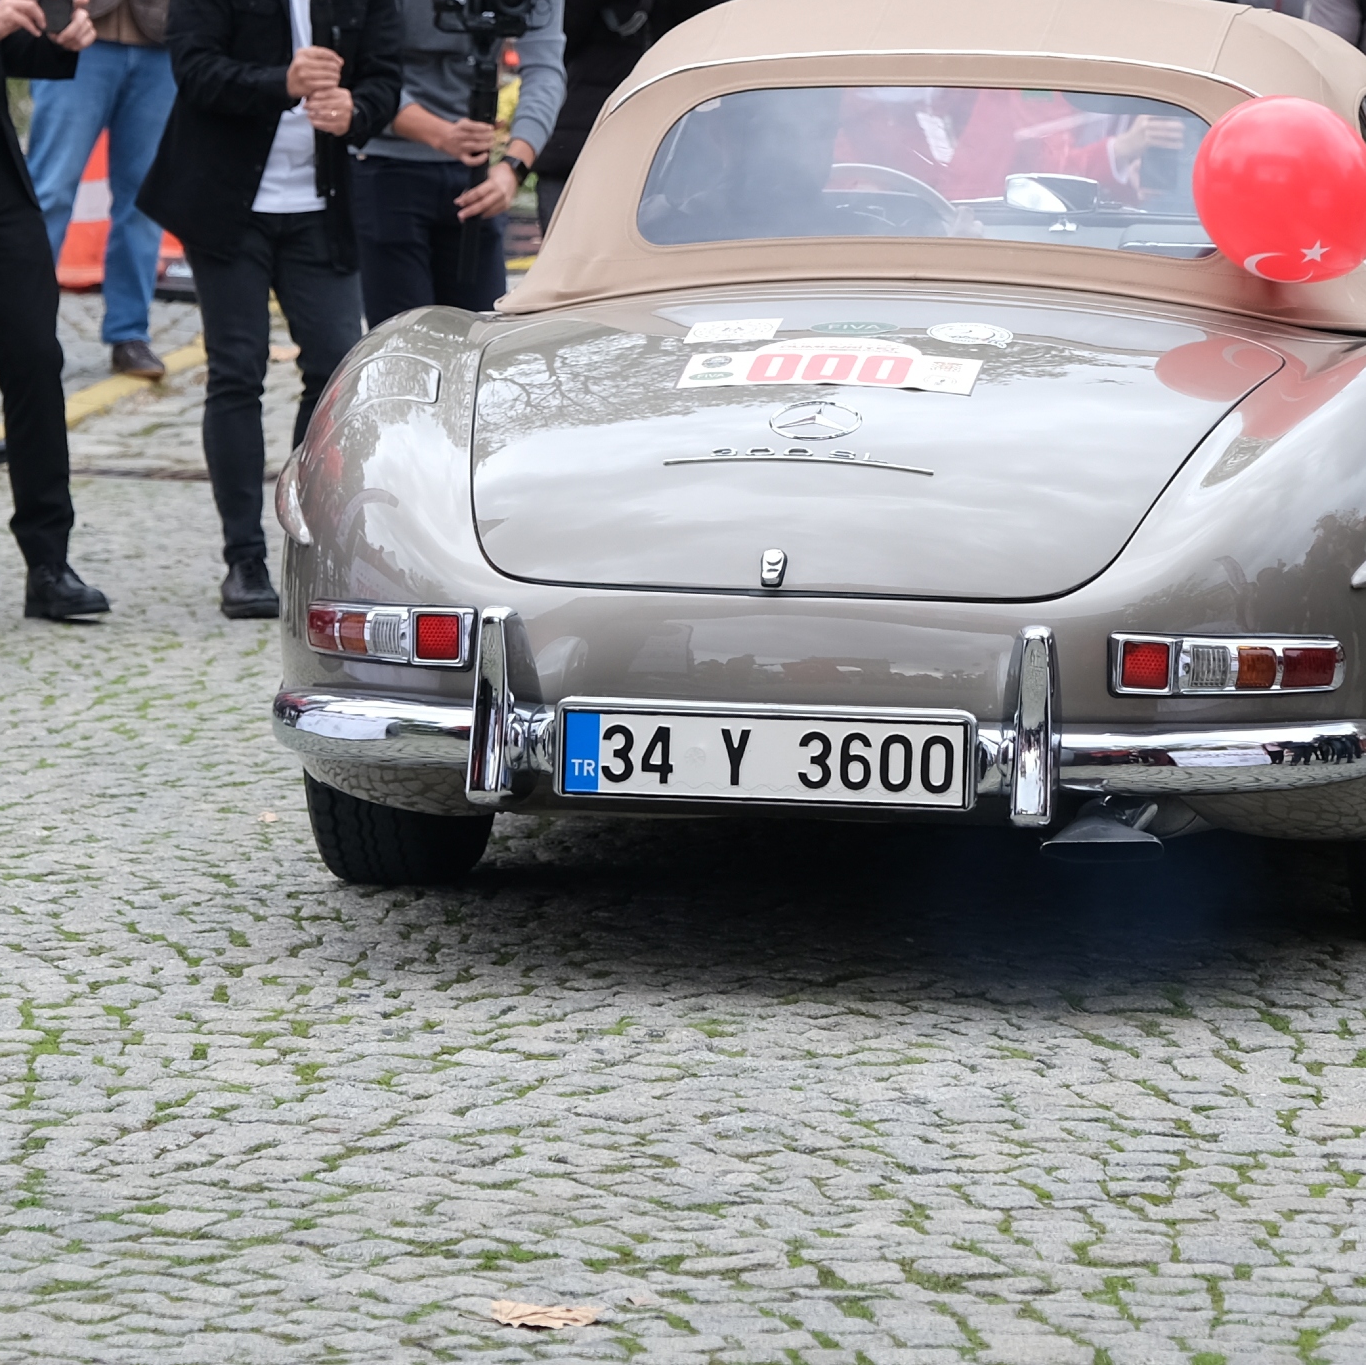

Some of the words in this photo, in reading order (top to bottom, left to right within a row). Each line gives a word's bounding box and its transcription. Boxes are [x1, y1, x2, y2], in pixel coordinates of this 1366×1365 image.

[828, 322, 881, 331] FIVA
[746, 354, 913, 384] 000
[571, 759, 595, 777] TR
[600, 724, 674, 785] 34
[721, 728, 752, 786] Y
[797, 731, 955, 794] 3600
